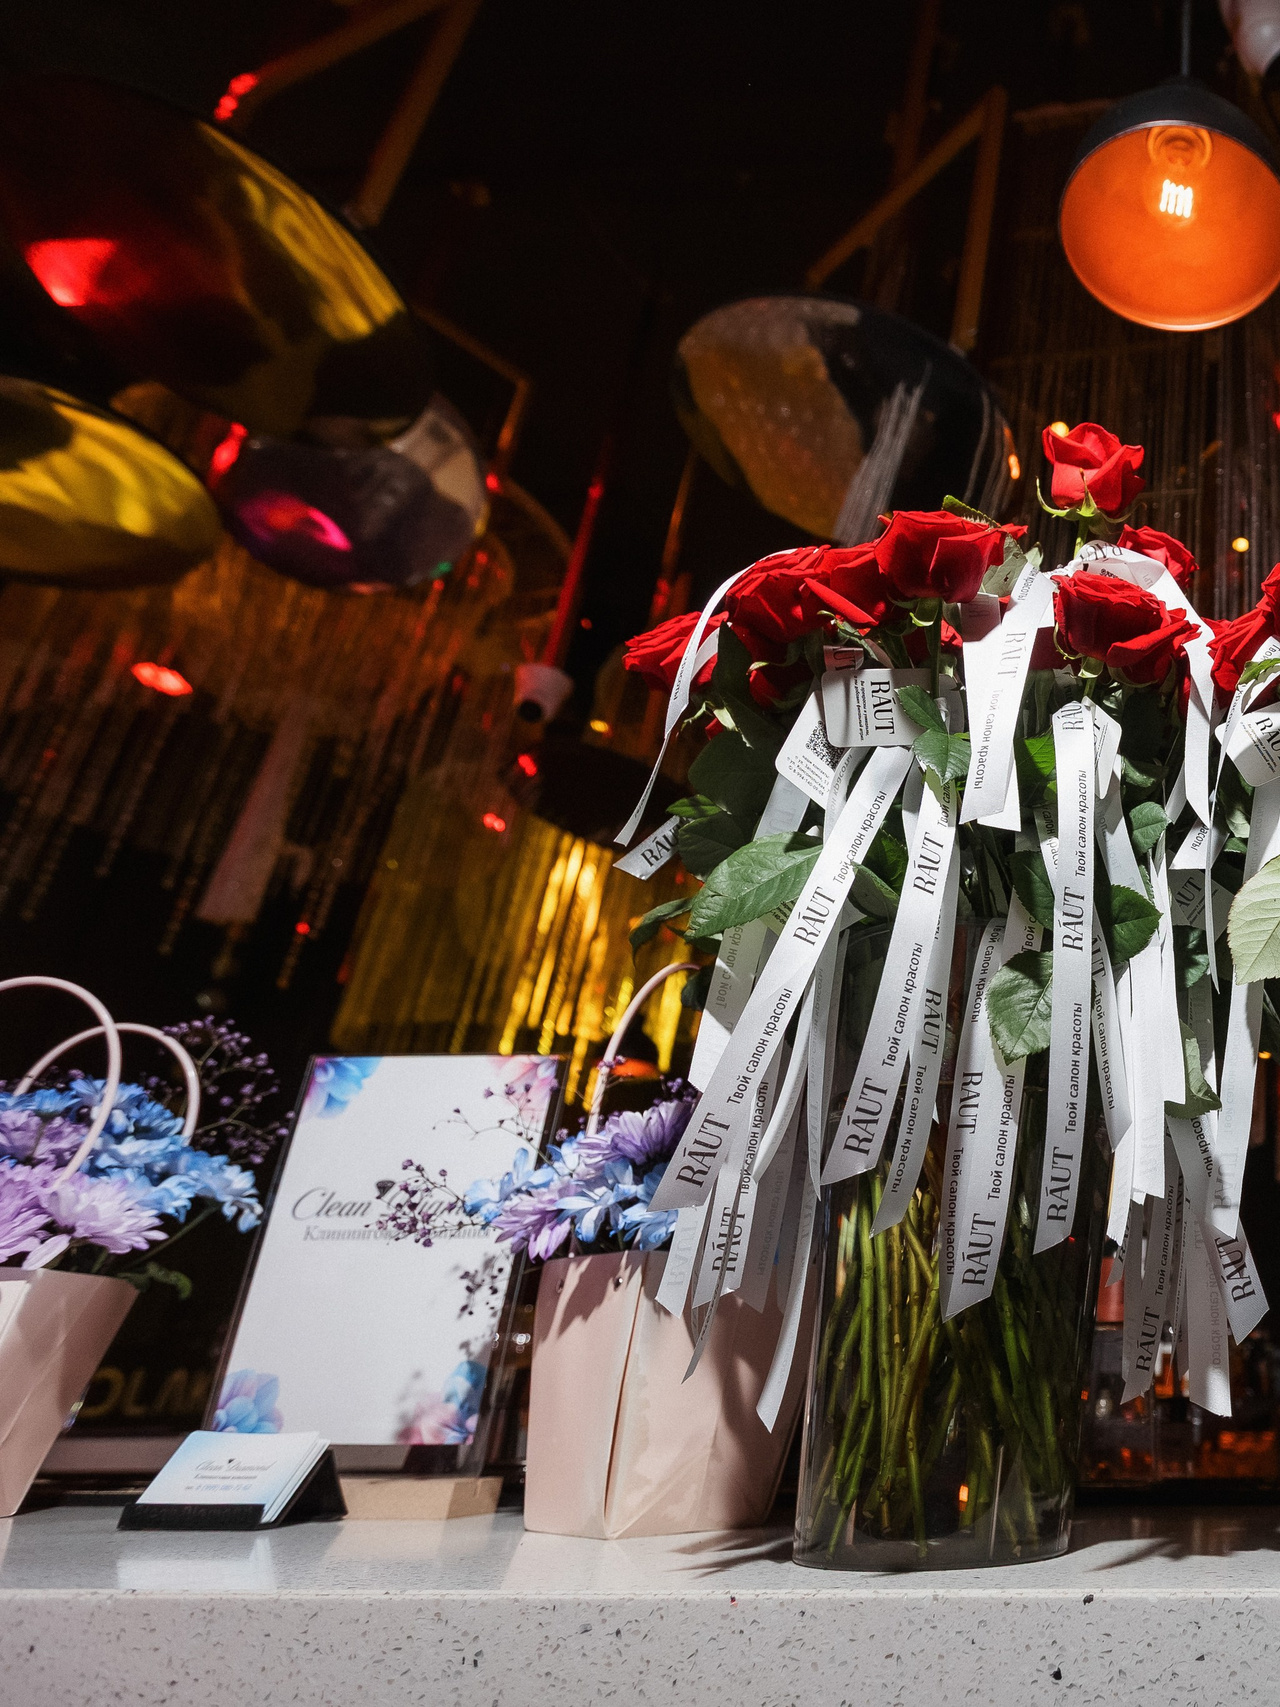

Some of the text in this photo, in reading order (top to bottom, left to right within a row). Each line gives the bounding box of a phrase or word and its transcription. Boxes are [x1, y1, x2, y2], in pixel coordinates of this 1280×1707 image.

[974, 743, 990, 790] красоты
[983, 711, 997, 744] салон
[833, 791, 887, 885] Твой салон красоты
[1075, 769, 1090, 878] Твой салон красоты
[881, 942, 923, 1068] Твой салон красоты
[970, 973, 987, 1023] красоты
[980, 944, 996, 976] салон
[727, 988, 793, 1105] Твой салон красоты
[1064, 1001, 1083, 1134] Твой салон красоты
[1097, 1019, 1108, 1056] салон
[1099, 1057, 1116, 1110] красоты
[751, 1081, 769, 1130] красоты
[891, 1065, 927, 1194] Твой салон красоты
[987, 1075, 1015, 1201] Твой салон красоты
[292, 1187, 372, 1221] Clean
[945, 1147, 964, 1275] Твой салон красоты
[1155, 1184, 1175, 1296] Твой салон красоты
